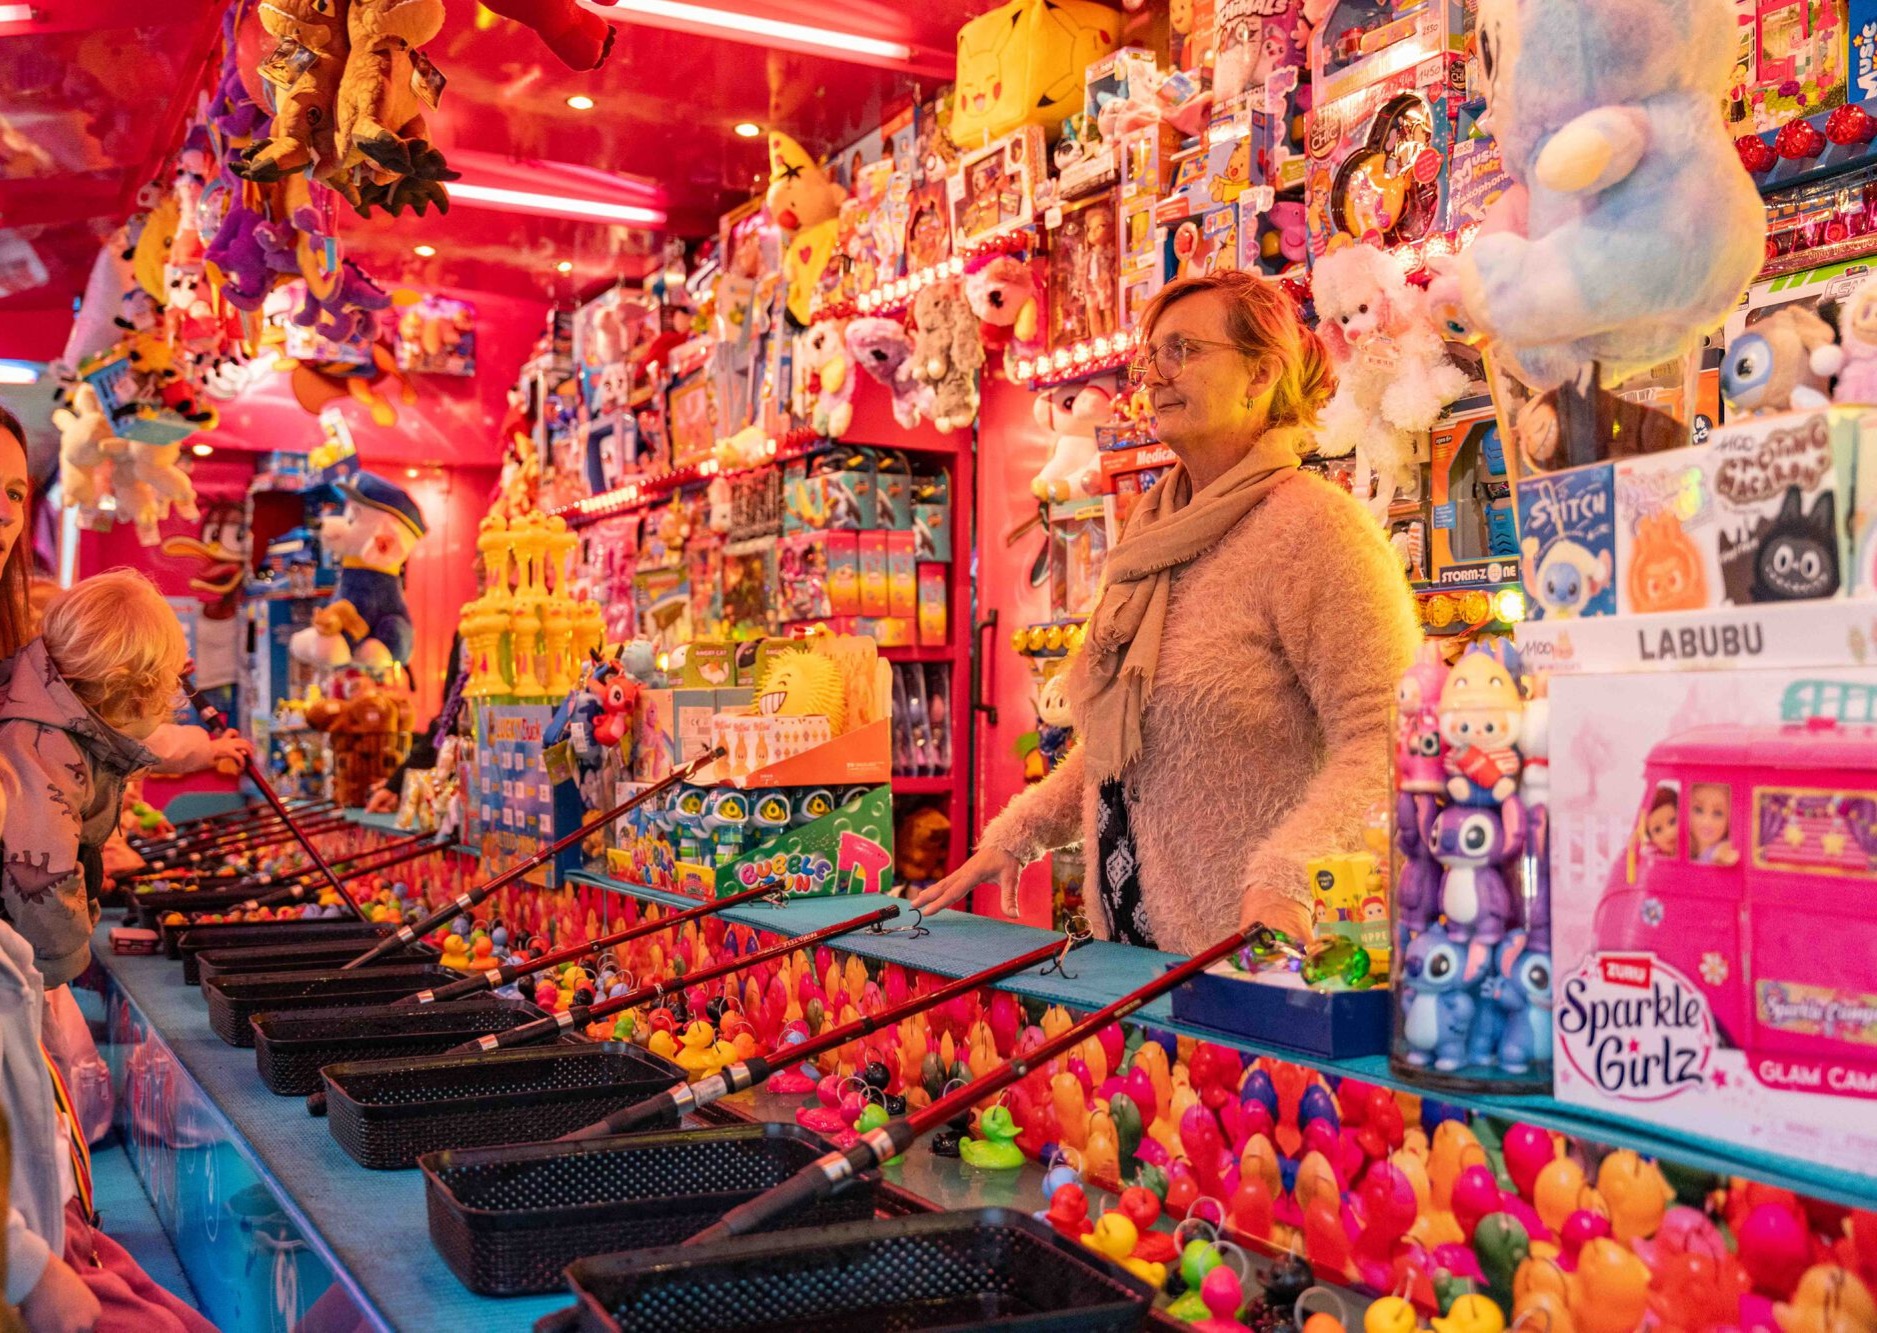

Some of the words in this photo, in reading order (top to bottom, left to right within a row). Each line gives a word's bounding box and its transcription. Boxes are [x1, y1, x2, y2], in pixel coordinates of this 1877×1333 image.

[1419, 65, 1441, 80] 1450
[1638, 622, 1763, 661] LABUBU
[740, 853, 833, 887] BUBBLE
[1606, 962, 1648, 985] ZURU
[1559, 979, 1700, 1047] Sparkle
[1597, 1035, 1703, 1092] Girlz
[1759, 1060, 1821, 1086] GLAM
